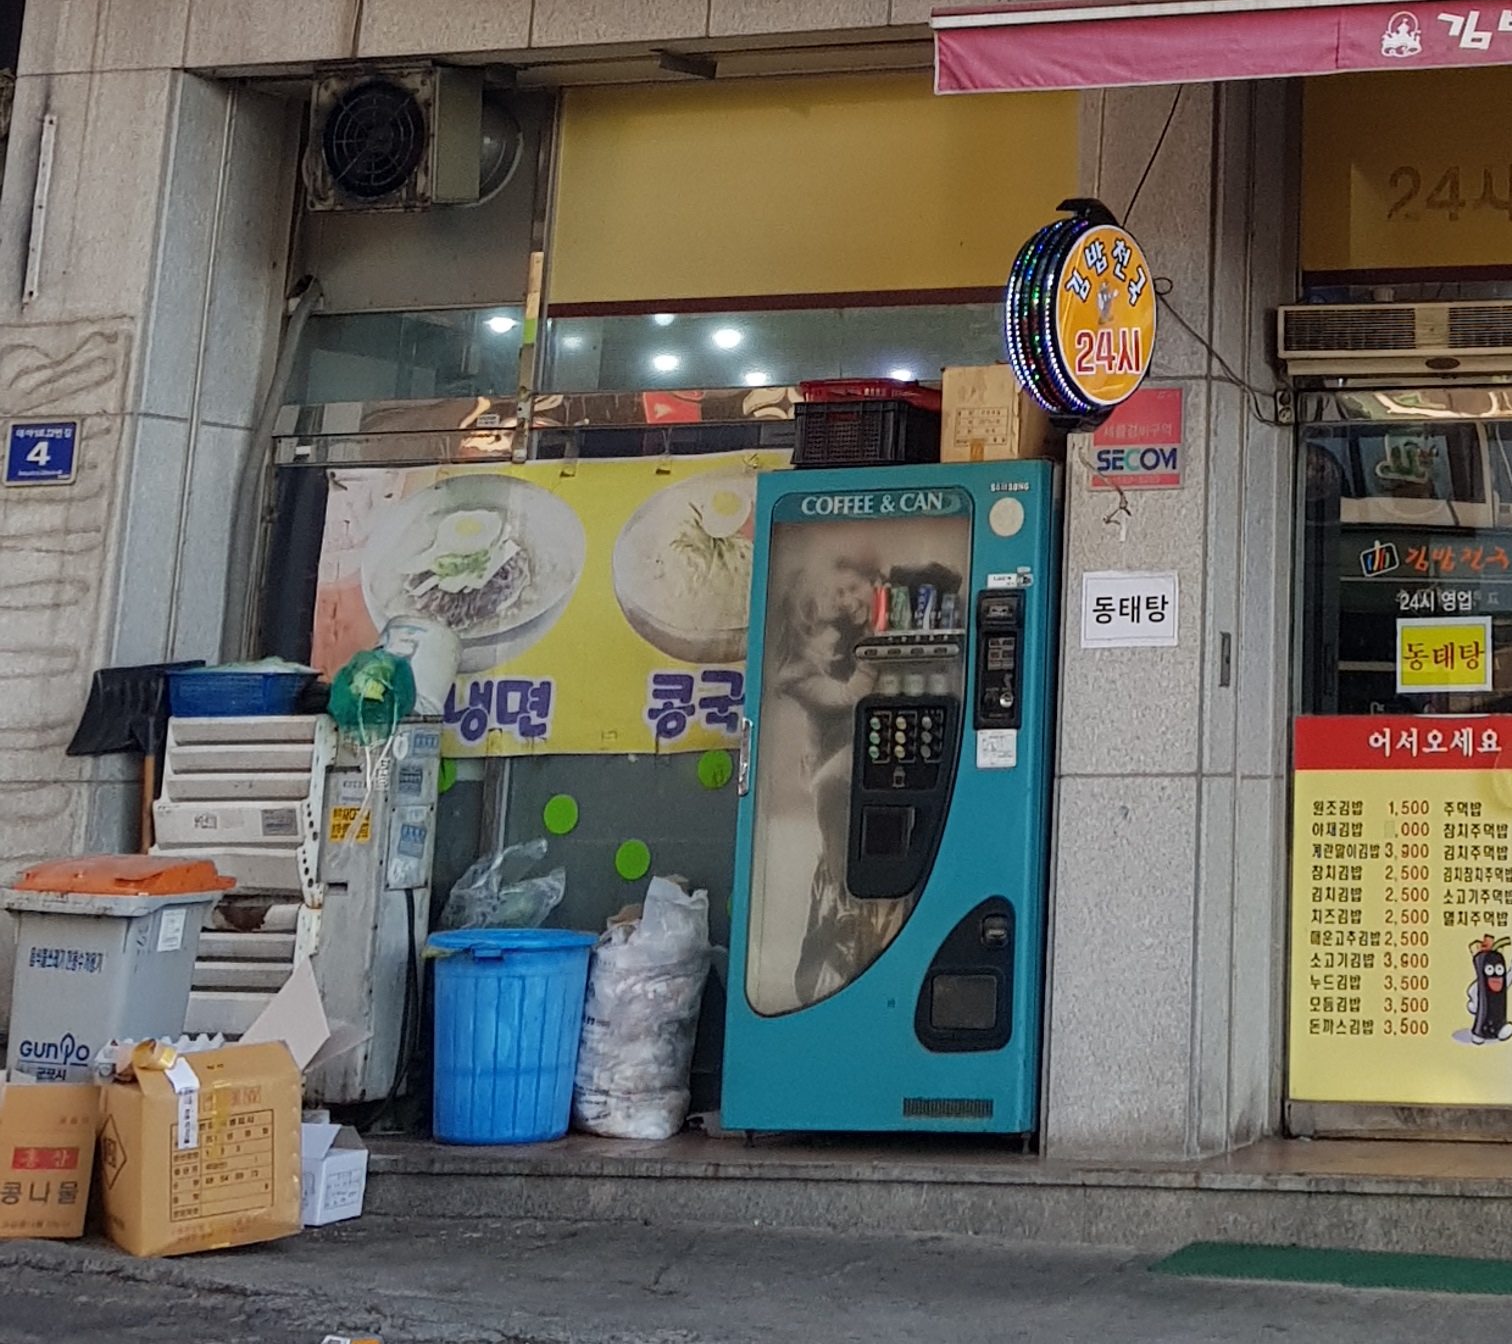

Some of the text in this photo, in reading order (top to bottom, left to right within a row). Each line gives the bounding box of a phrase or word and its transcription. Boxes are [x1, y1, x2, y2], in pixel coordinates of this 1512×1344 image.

[1065, 238, 1145, 305] 김밥천국
[1076, 327, 1142, 375] 24시
[26, 441, 51, 466] 4
[1097, 448, 1177, 471] SECOM
[801, 495, 874, 515] COFFEE
[900, 492, 943, 510] CAN
[1092, 595, 1169, 624] 동태탕
[1401, 591, 1472, 611] 24시 영업
[1404, 641, 1485, 671] 동태탕
[1369, 727, 1502, 758] 어서오세요
[1312, 800, 1429, 816] 원조김밥 1,500
[1443, 801, 1482, 817] 주먹밥
[1311, 822, 1363, 838] 야채김밥
[1443, 823, 1508, 839] 참치주먹밥
[1443, 845, 1508, 861] 김치주먹밥
[1311, 865, 1429, 881] 참치김밥 2,500
[1311, 887, 1429, 903] 김치김밥 2,500
[1310, 909, 1429, 925] 치즈김밥 2,500
[1443, 911, 1508, 927] 멸치주먹밥
[1384, 931, 1429, 947] 2,500
[1310, 952, 1375, 969] 소고기김밥
[1310, 974, 1429, 990] 누드김밥 3,500
[1309, 996, 1429, 1013] 모듬김밥 3,500
[1309, 1018, 1429, 1035] 돈까스김밥 3,500
[1, 1181, 79, 1205] 콩나물
